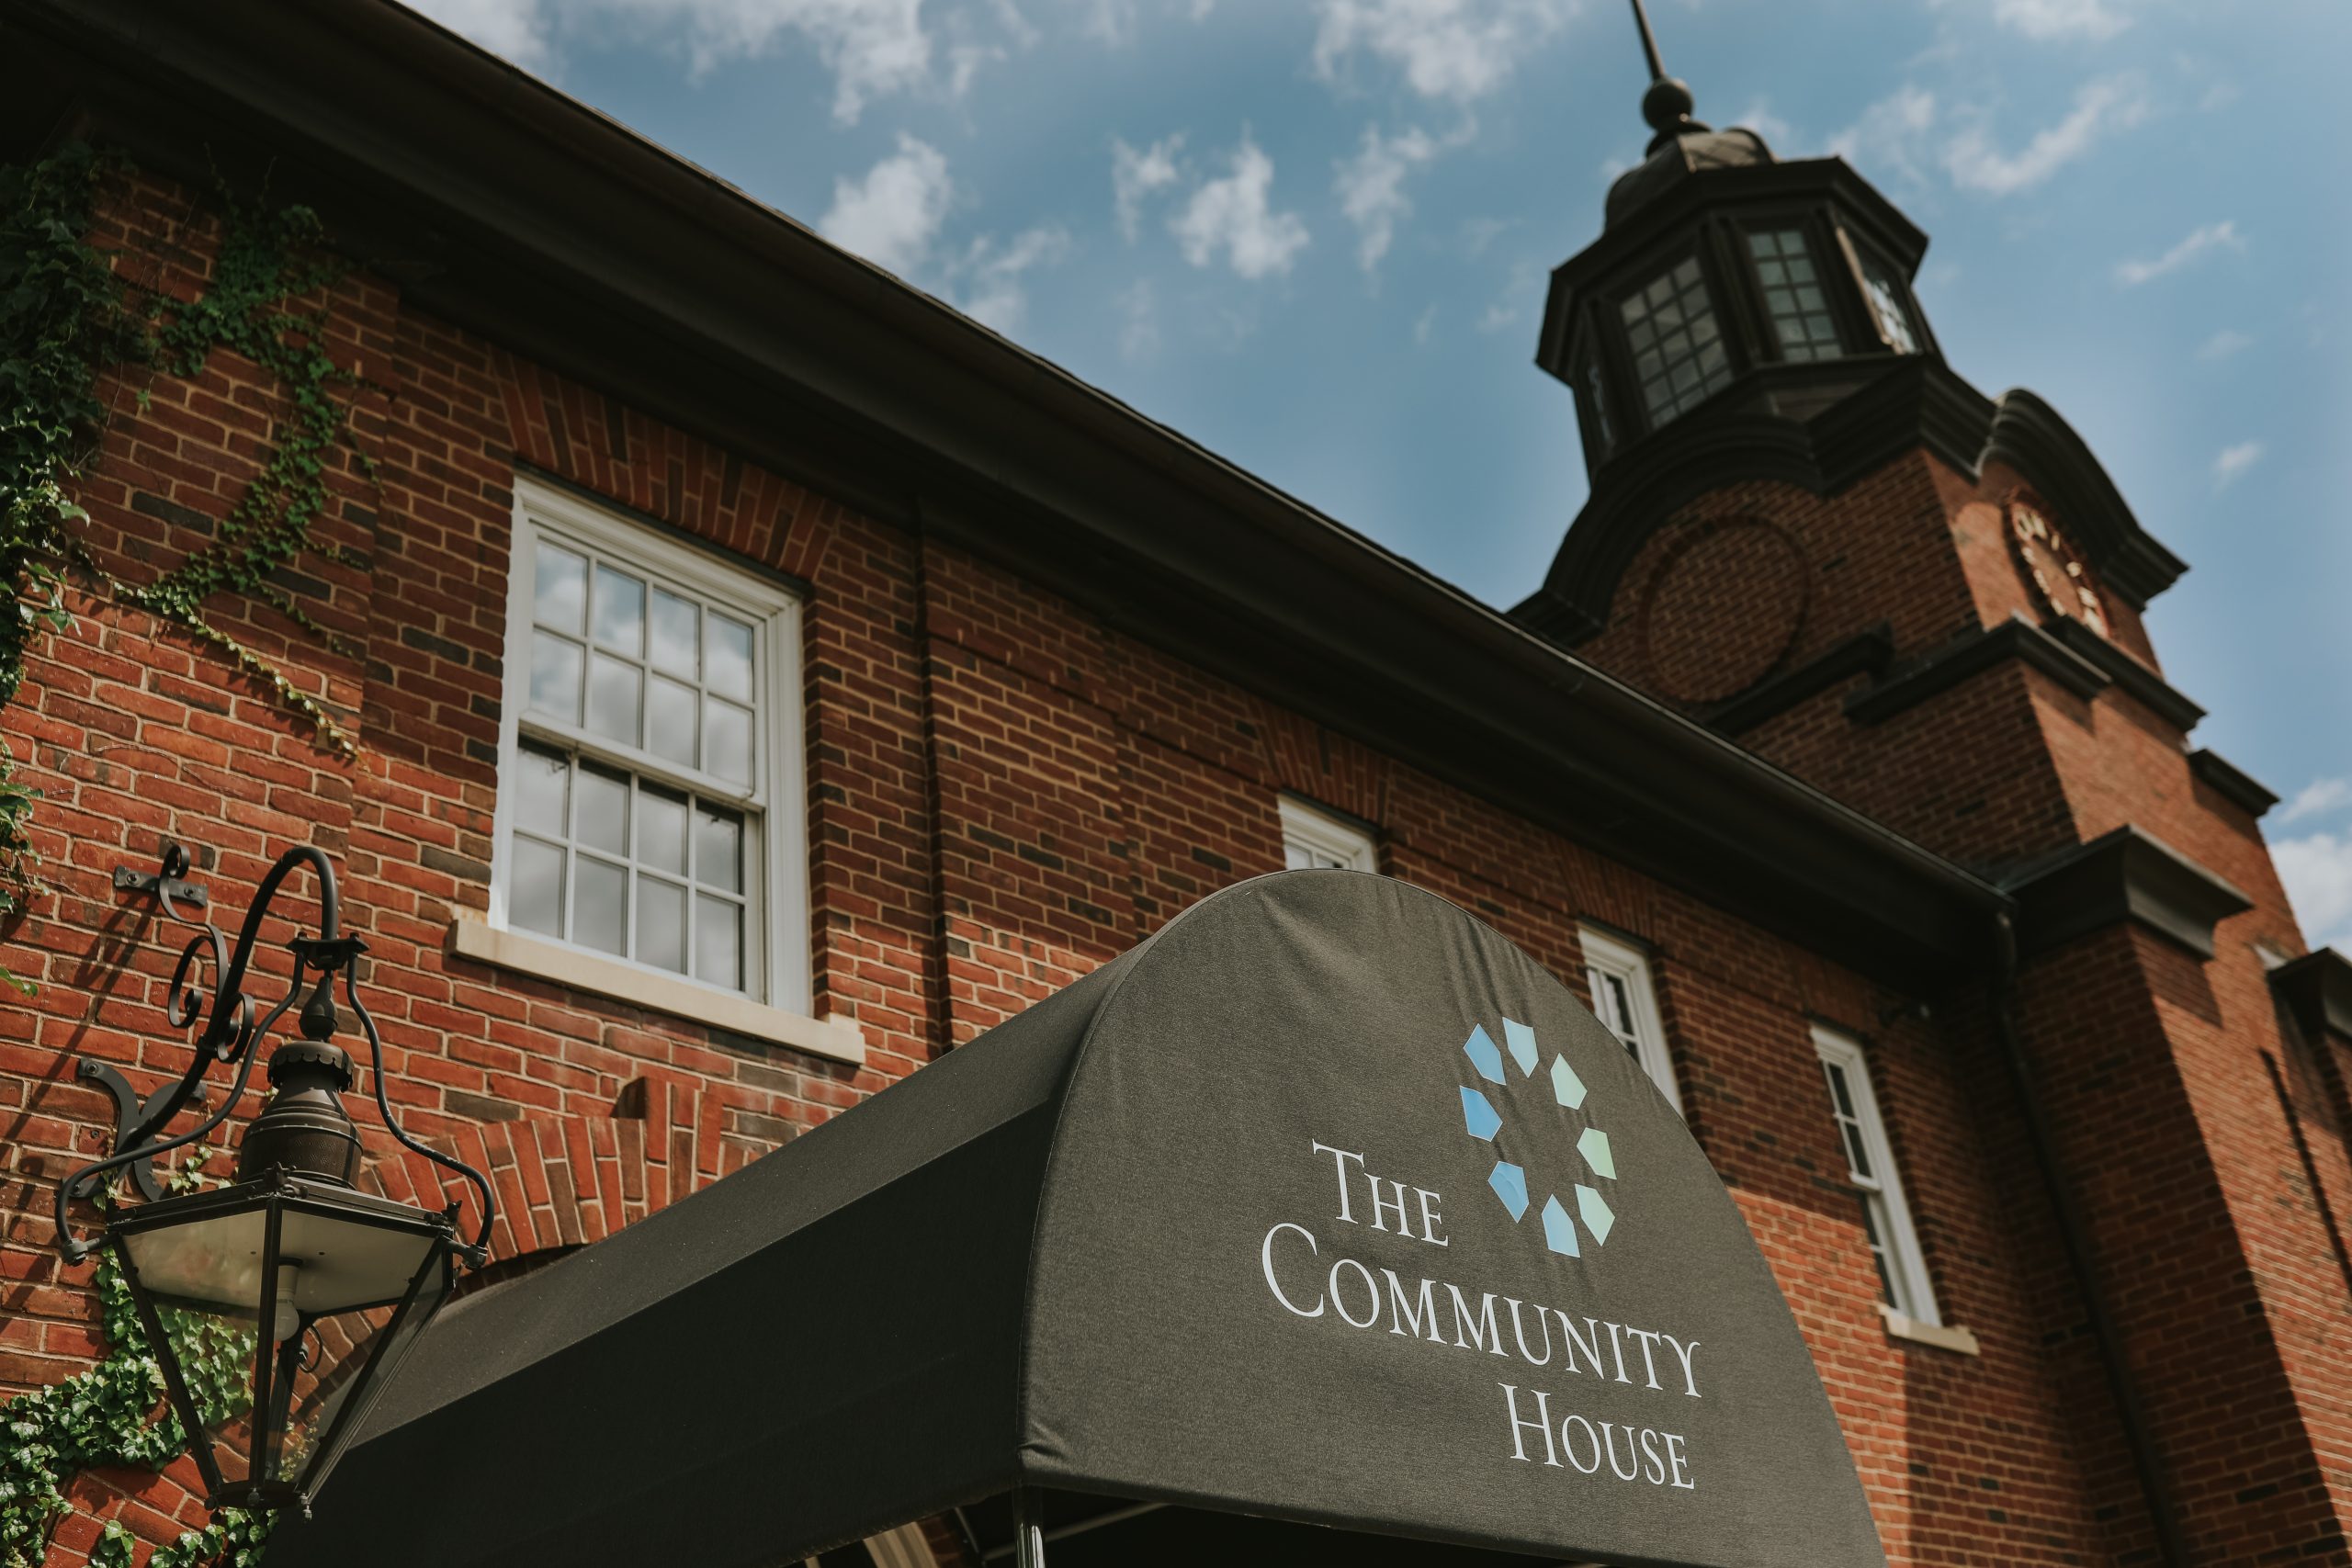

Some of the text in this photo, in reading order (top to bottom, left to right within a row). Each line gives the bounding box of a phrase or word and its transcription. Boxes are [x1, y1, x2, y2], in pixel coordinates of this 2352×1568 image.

[1312, 1138, 1449, 1247] THE
[1261, 1223, 1702, 1398] COMMUNITY
[1498, 1382, 1695, 1490] HOUSE
